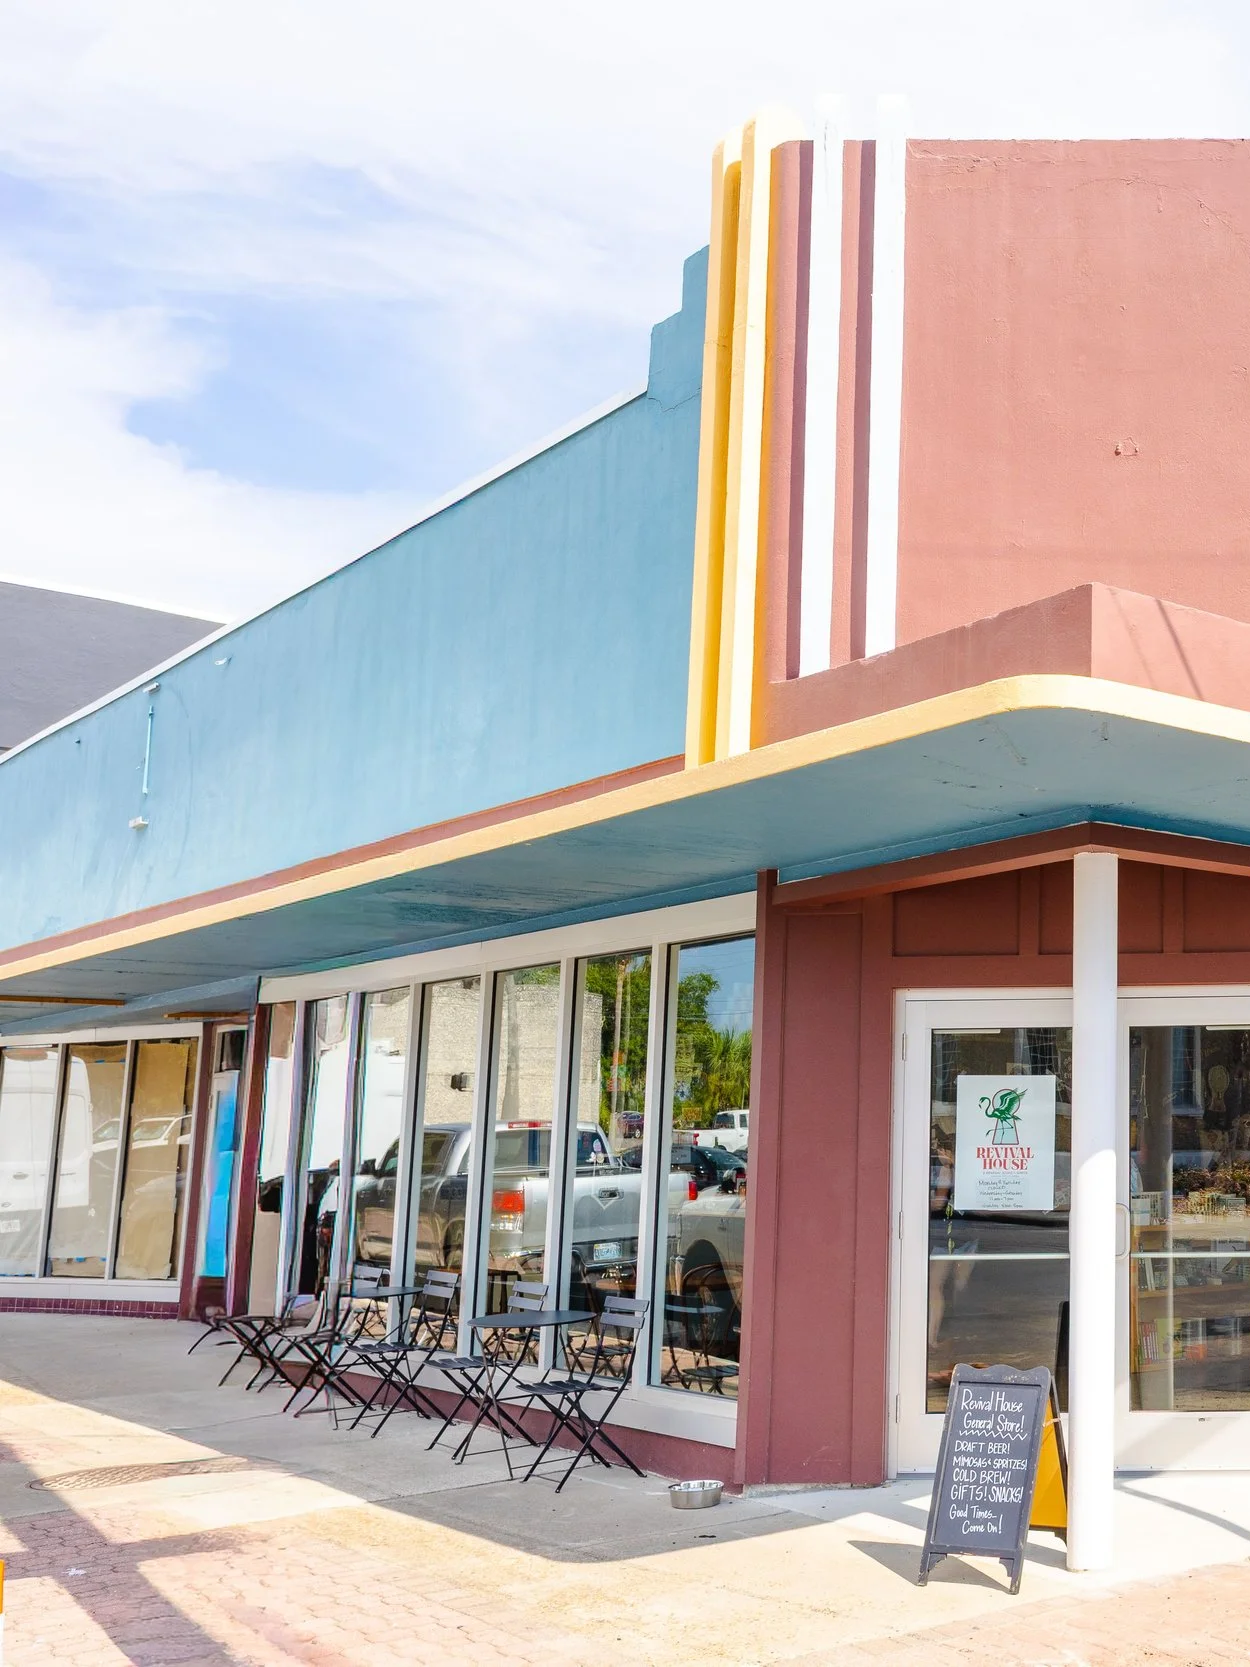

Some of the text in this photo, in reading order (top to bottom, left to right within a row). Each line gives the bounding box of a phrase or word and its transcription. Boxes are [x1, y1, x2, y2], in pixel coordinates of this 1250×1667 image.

[976, 1147, 1034, 1158] REVIVAL
[983, 1159, 1028, 1170] HOUSE
[961, 1389, 1023, 1412] Revival House
[963, 1412, 1025, 1433] General Store!
[955, 1440, 1010, 1454] DRAFT BEER!
[953, 1468, 1011, 1485] COLD BREW!
[988, 1486, 1024, 1503] SNACKS!
[949, 1504, 968, 1520] Good
[962, 1514, 1003, 1535] Come On!
